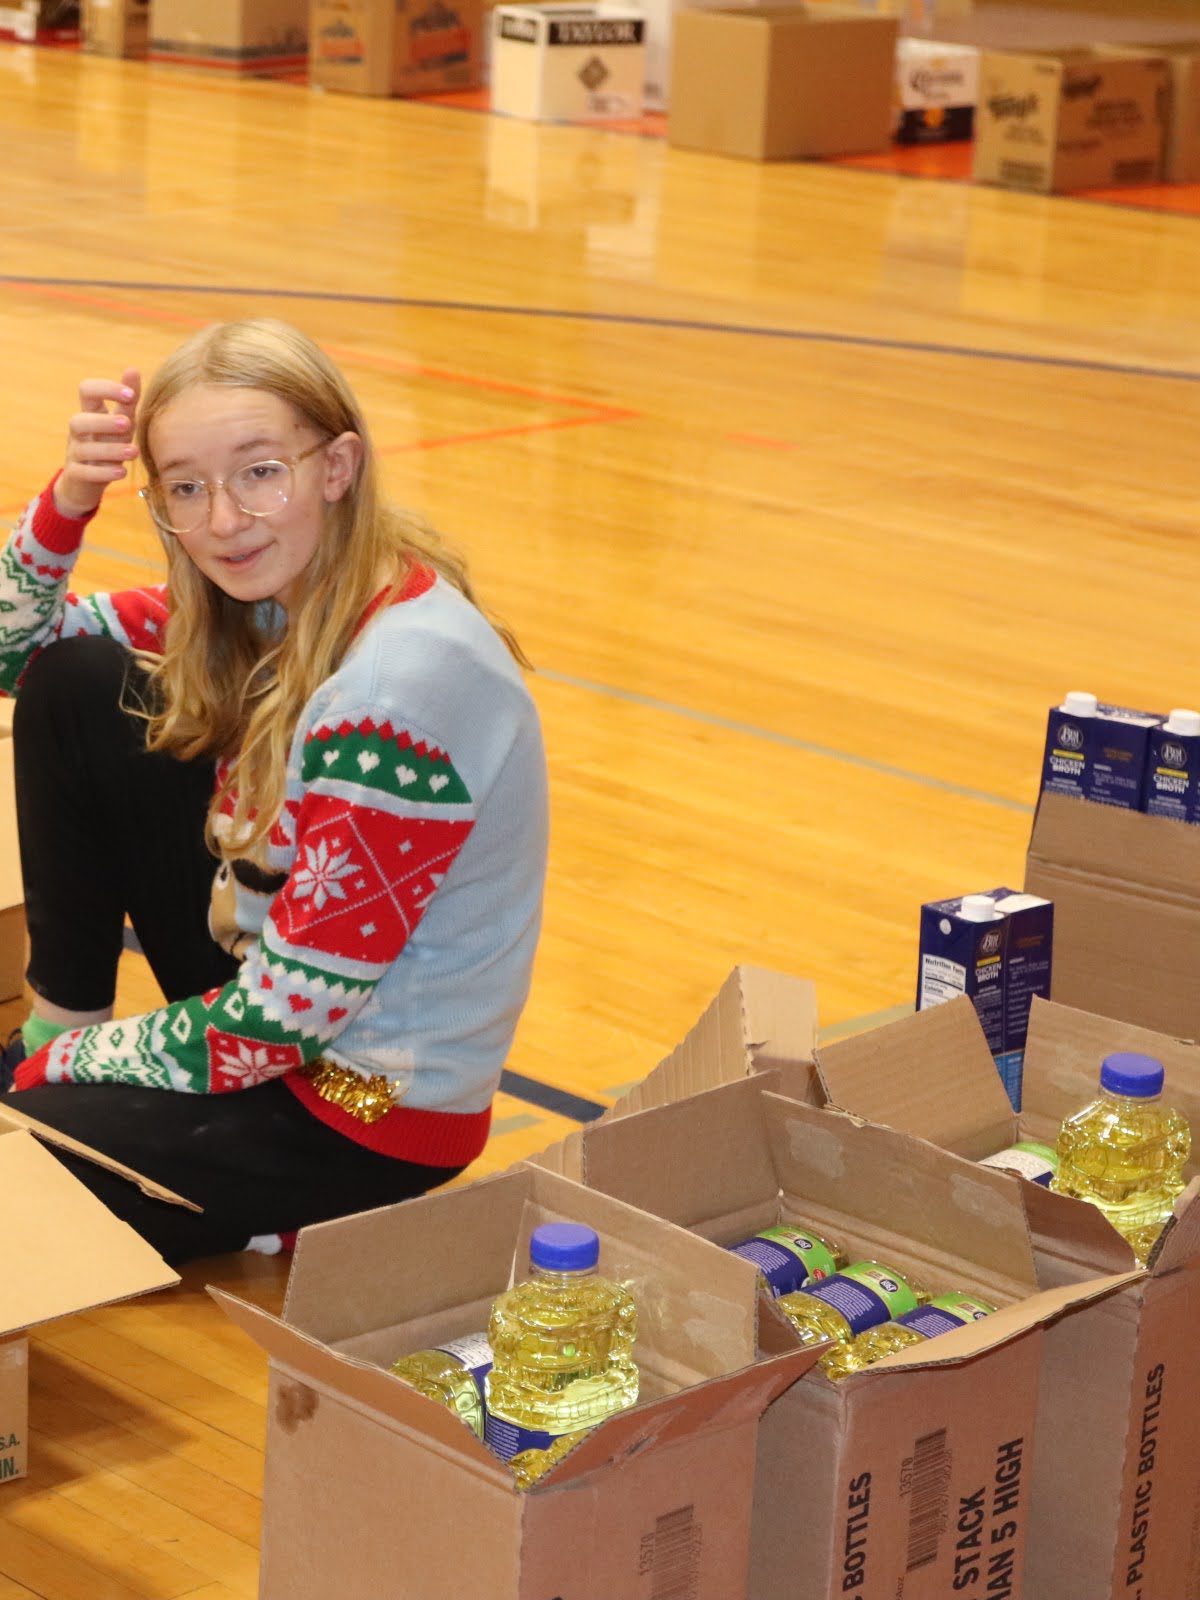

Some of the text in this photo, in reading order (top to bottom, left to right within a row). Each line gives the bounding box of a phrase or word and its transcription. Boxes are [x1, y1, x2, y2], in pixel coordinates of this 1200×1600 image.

[992, 1436, 1024, 1516] HIGH
[1126, 1363, 1165, 1586] PLASTIC BOTTLES
[842, 1471, 872, 1592] BOTTLES
[952, 1486, 987, 1591] STACK
[991, 1520, 1017, 1544] 5
